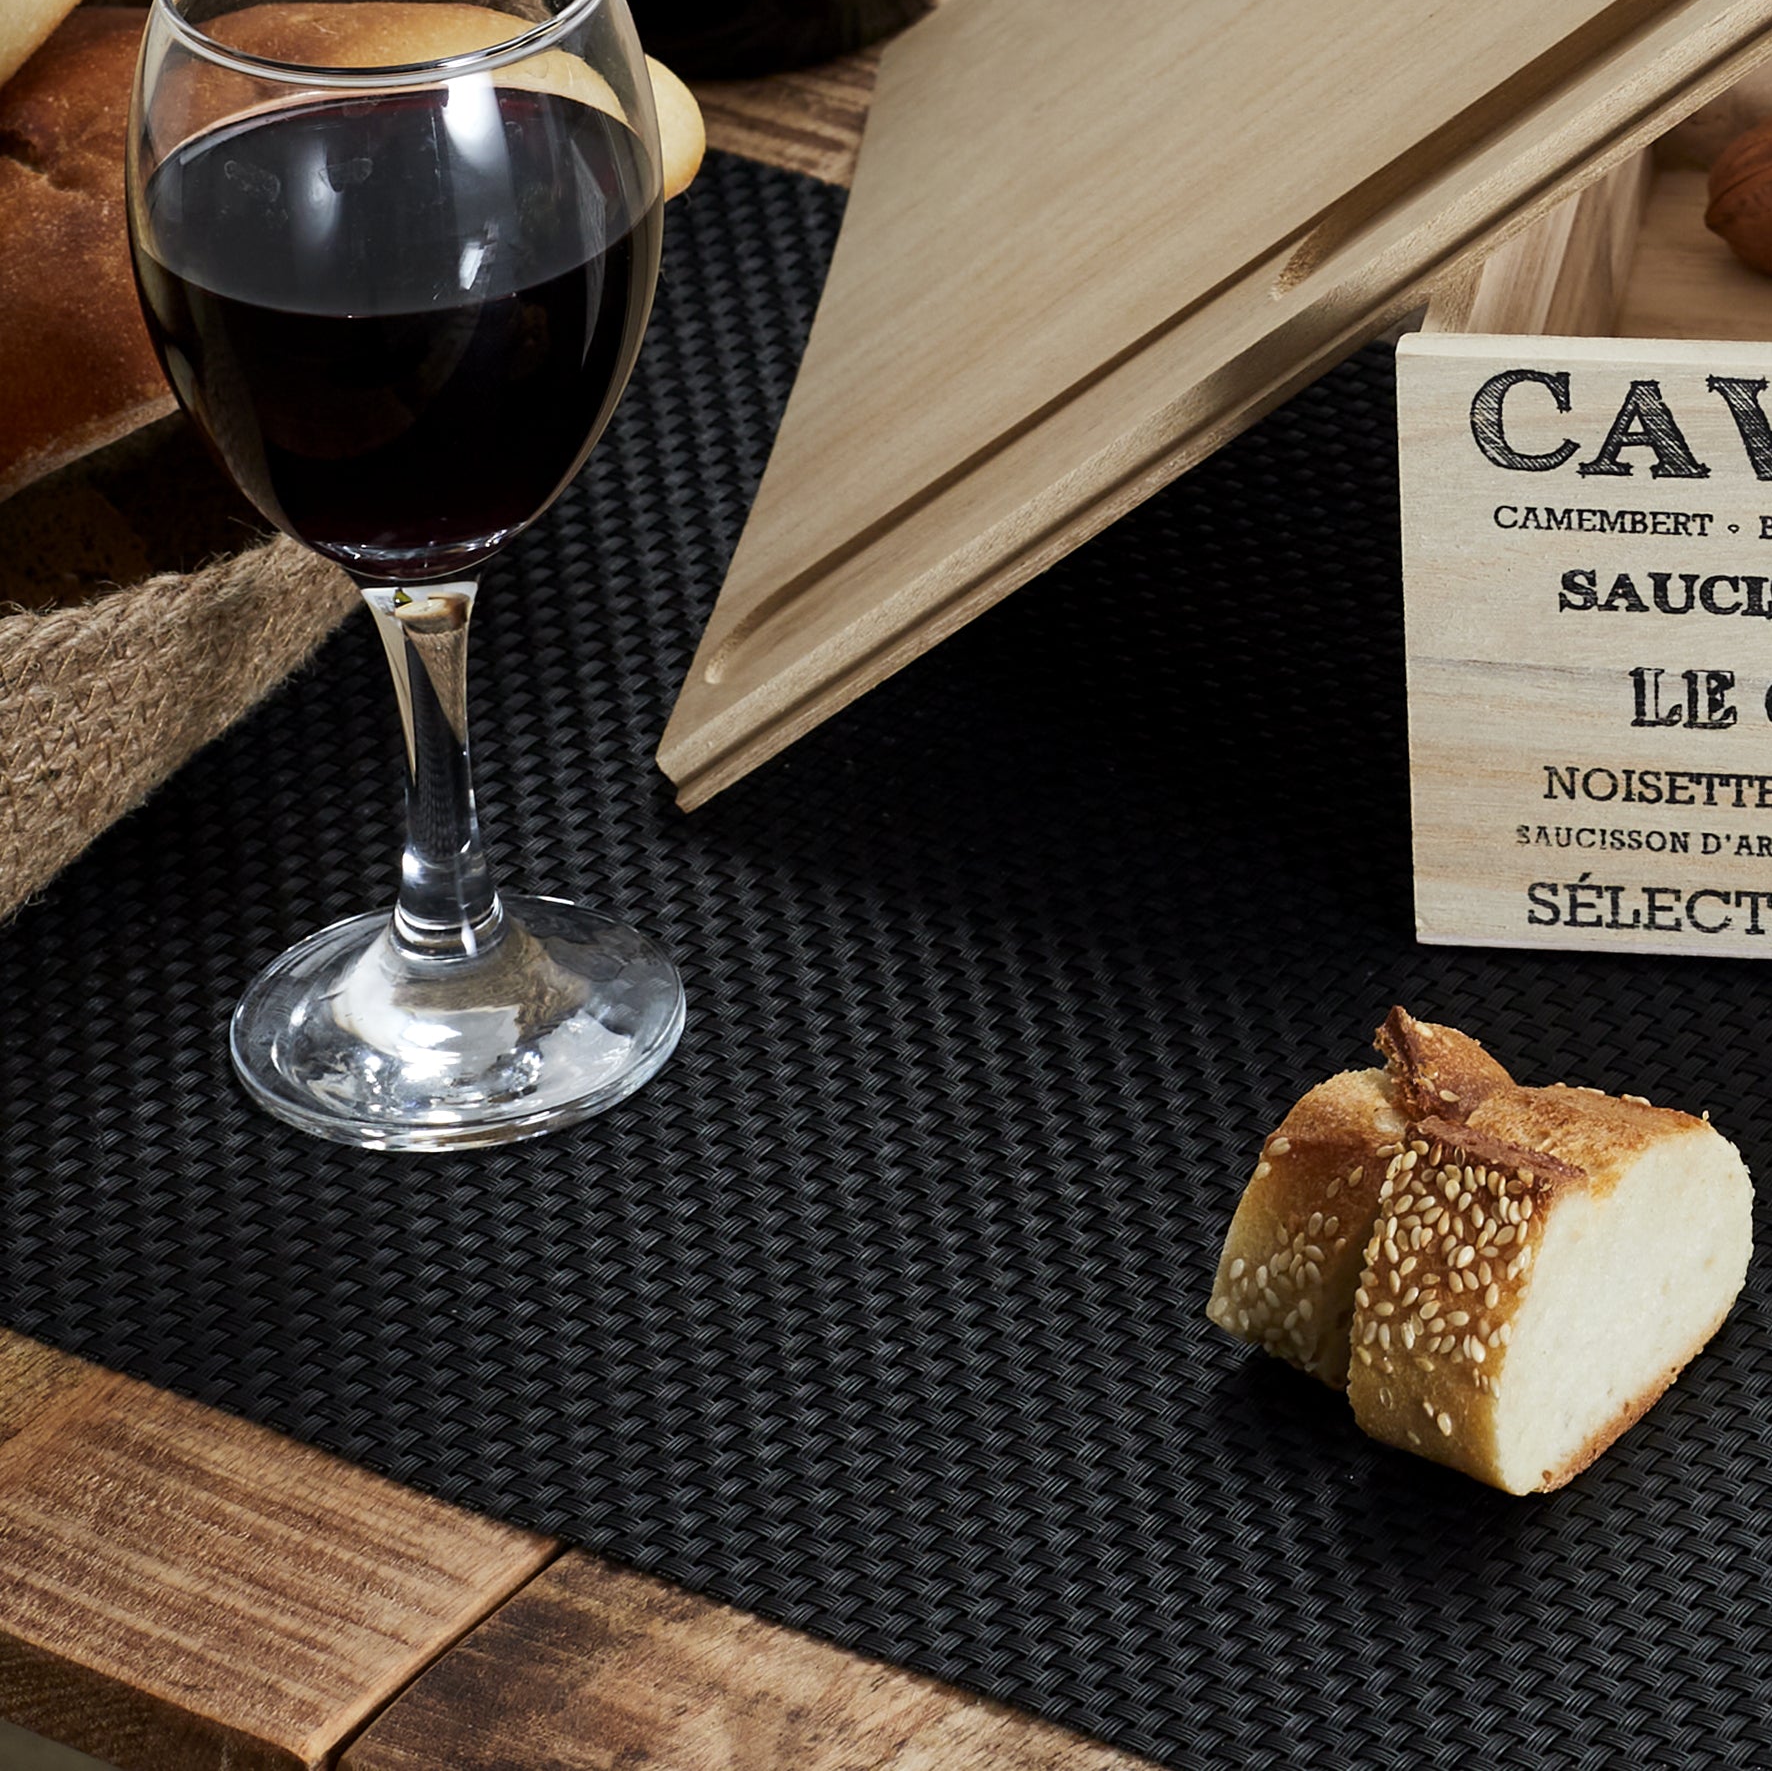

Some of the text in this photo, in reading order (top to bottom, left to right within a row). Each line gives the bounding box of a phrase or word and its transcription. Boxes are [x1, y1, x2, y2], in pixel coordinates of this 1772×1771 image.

[1493, 505, 1714, 538] CAMEMBERT
[1627, 666, 1738, 731] LE
[1515, 824, 1691, 854] SAUCISSON
